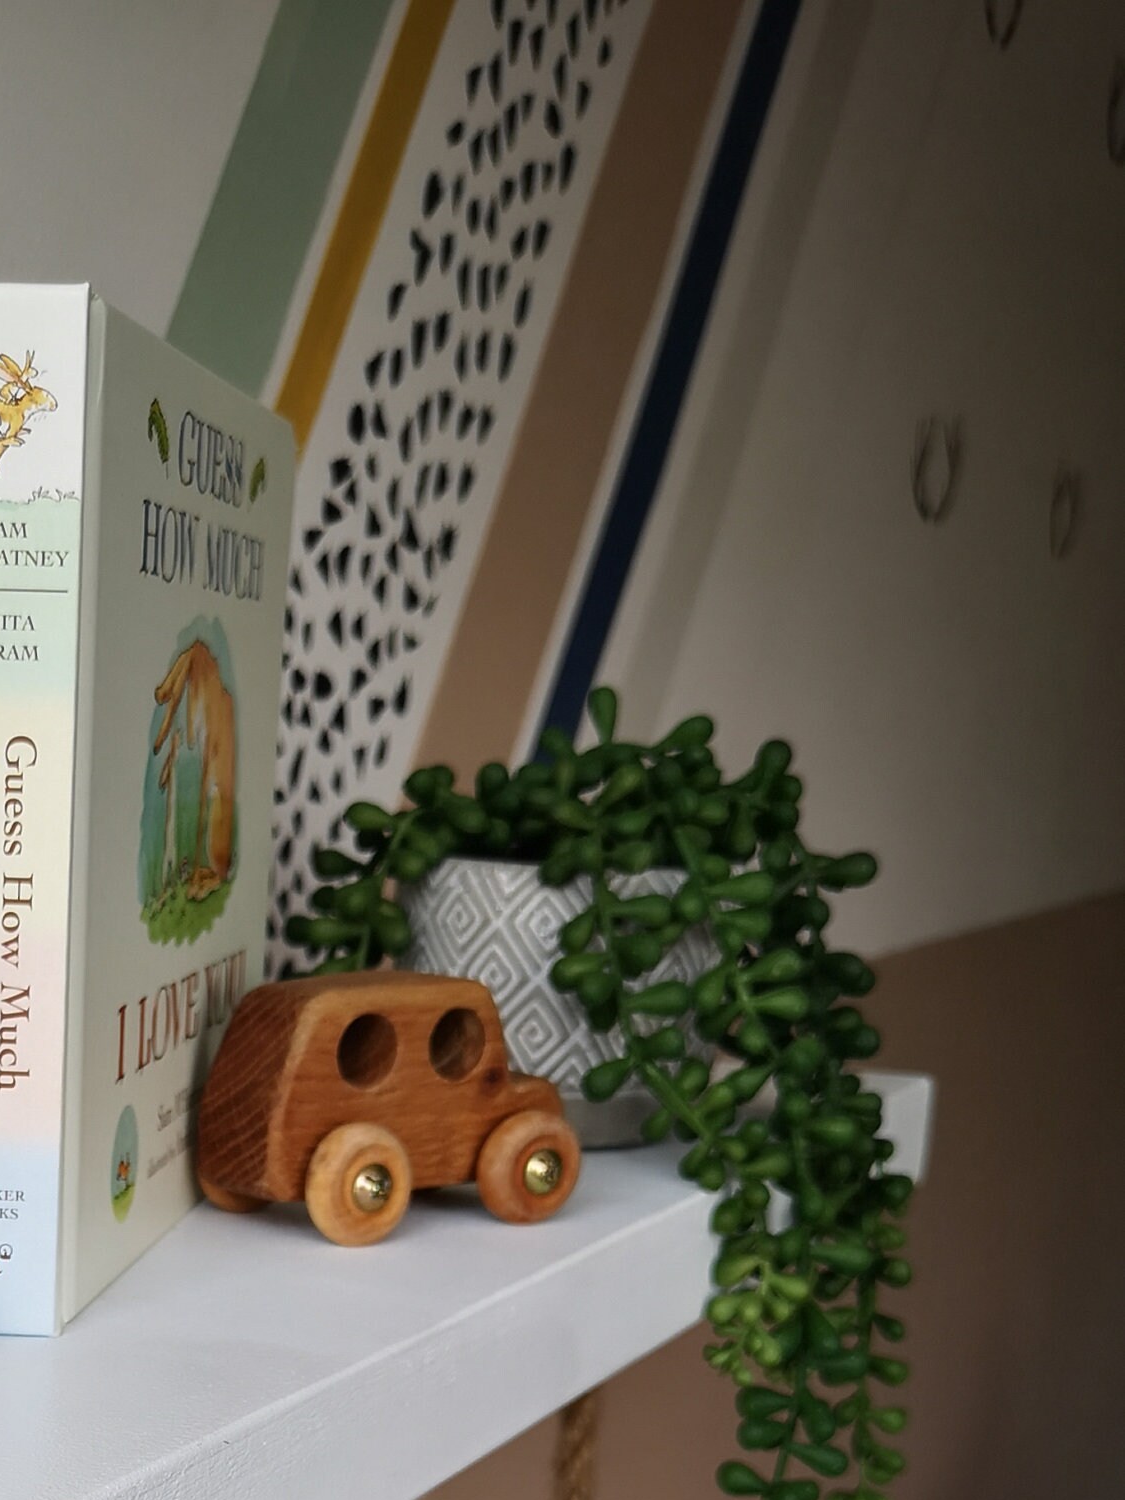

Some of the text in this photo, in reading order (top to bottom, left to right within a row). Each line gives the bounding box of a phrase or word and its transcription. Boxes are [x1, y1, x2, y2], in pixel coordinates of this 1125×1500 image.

[178, 411, 243, 508] GUESS
[139, 499, 264, 600] HOW MUCH
[0, 735, 38, 1091] Guess How Much
[116, 1004, 127, 1084] I
[135, 971, 200, 1074] LOVE
